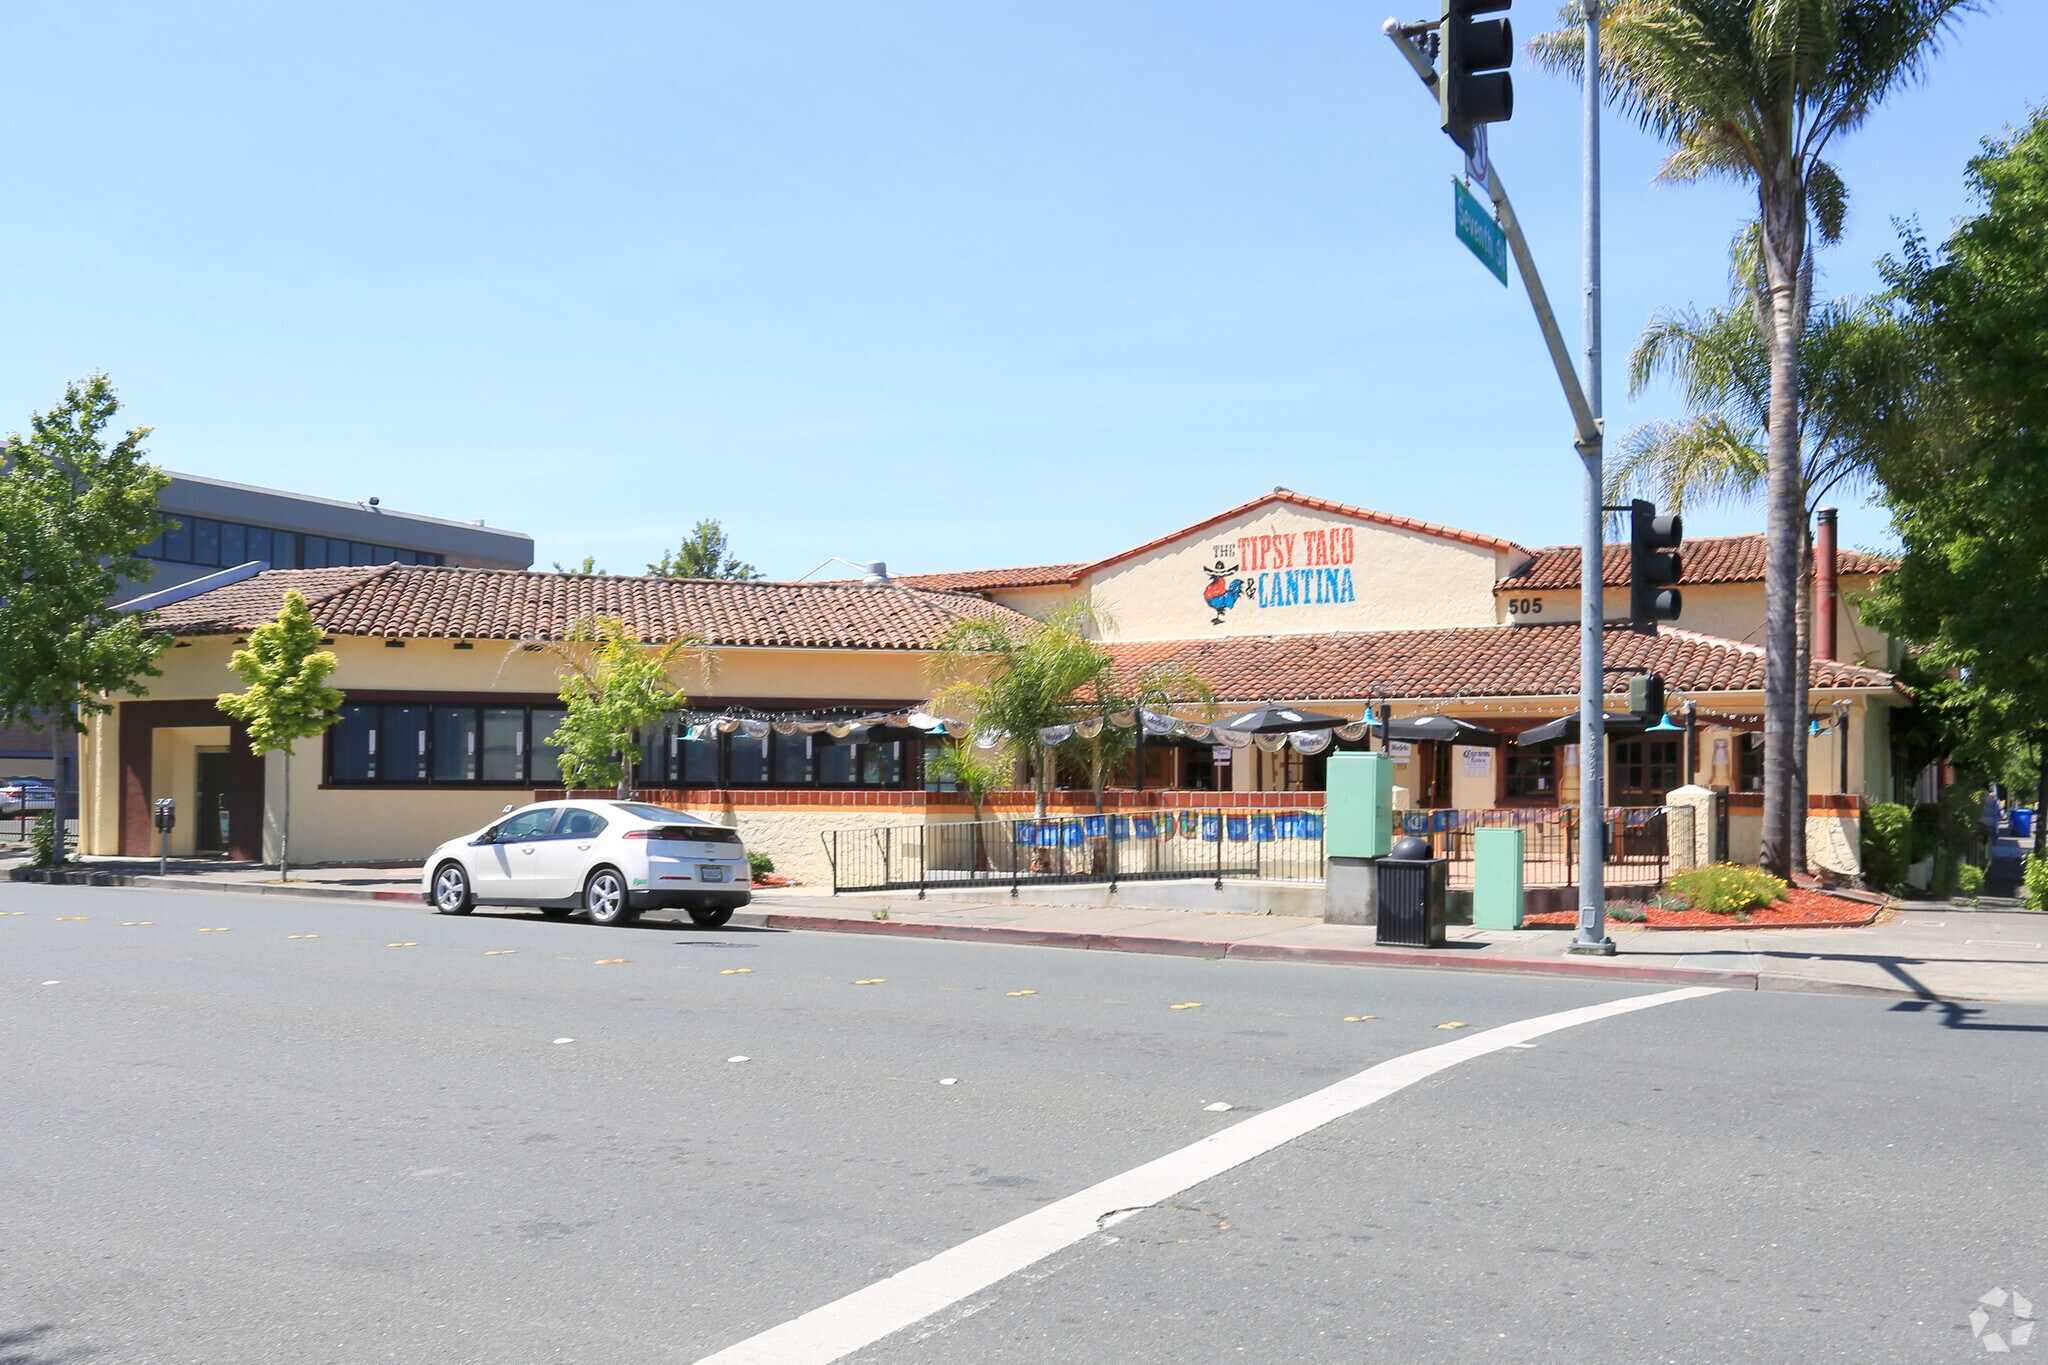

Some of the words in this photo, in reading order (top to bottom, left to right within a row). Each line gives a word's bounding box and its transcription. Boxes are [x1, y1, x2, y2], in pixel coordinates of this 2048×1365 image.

[1457, 195, 1494, 258] Seventh
[1496, 238, 1506, 271] St
[1213, 543, 1236, 558] THE
[1237, 532, 1298, 572] TIPSY
[1303, 526, 1355, 567] TACO
[1245, 577, 1257, 600] &
[1258, 567, 1355, 609] CANTINA
[1509, 597, 1543, 614] 505
